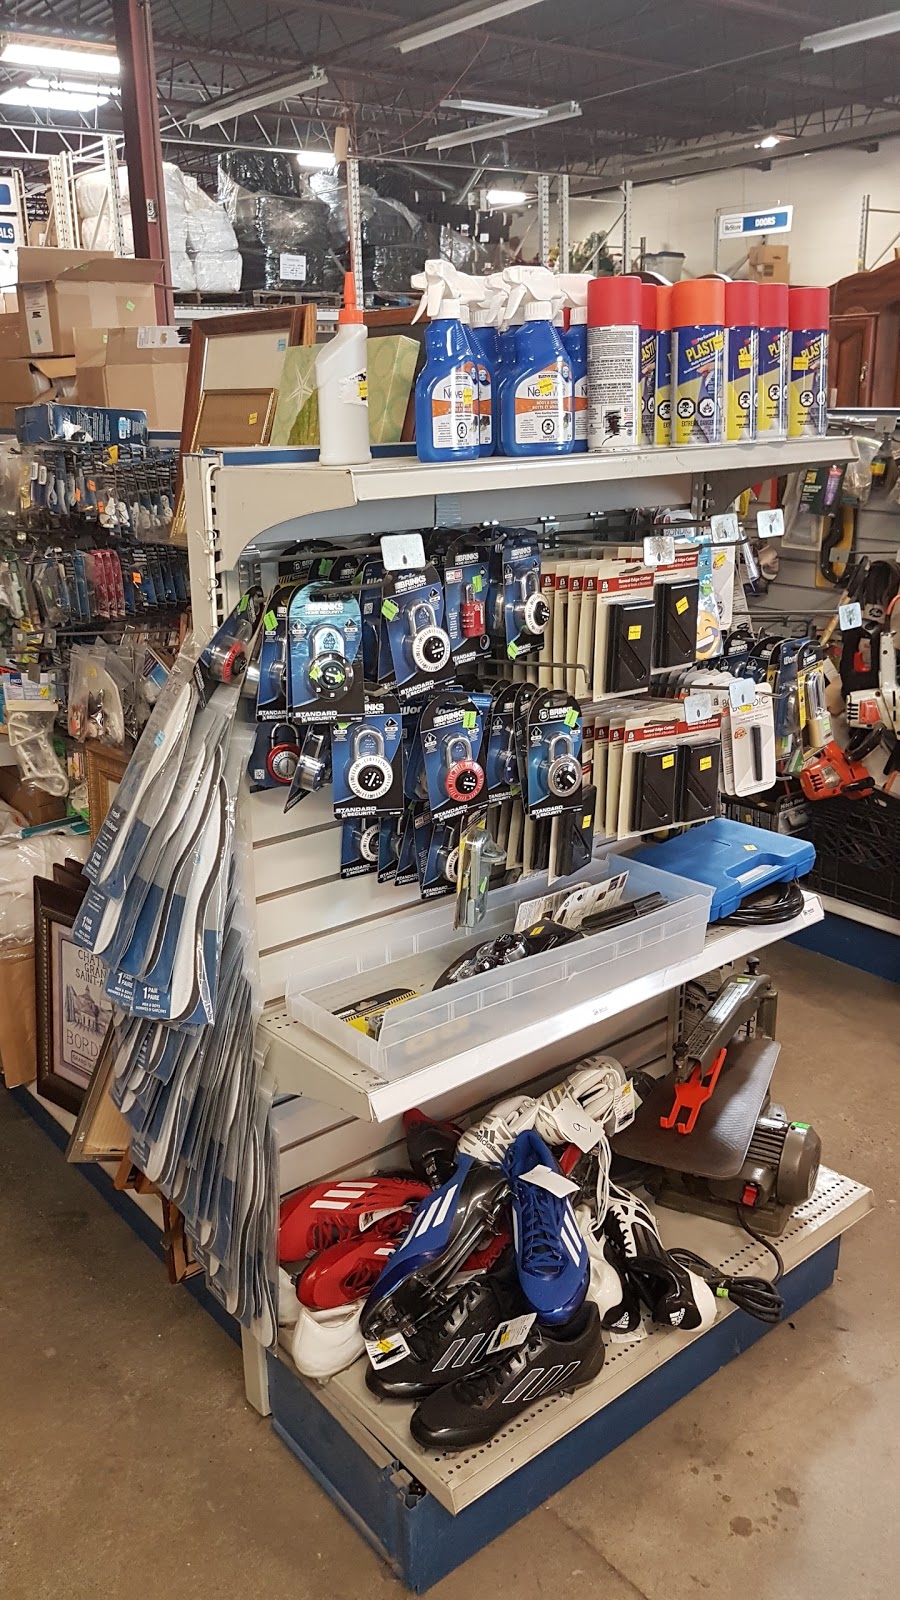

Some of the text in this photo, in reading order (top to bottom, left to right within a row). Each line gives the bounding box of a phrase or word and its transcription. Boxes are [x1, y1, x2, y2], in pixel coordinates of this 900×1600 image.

[755, 216, 776, 228] DOORS
[685, 338, 715, 363] PLAST
[460, 552, 479, 561] BRINKS
[401, 575, 427, 588] BRINKS
[309, 602, 344, 611] BRINKS
[400, 679, 435, 695] STANDARD
[335, 805, 377, 814] STANDARD
[434, 804, 468, 818] STANDARD
[531, 804, 564, 815] STANDARD
[118, 972, 123, 984] 1
[122, 979, 133, 989] PAIRE
[143, 986, 158, 999] 1 PAIR
[147, 993, 160, 1001] PAIRE
[474, 1131, 496, 1151] adidas
